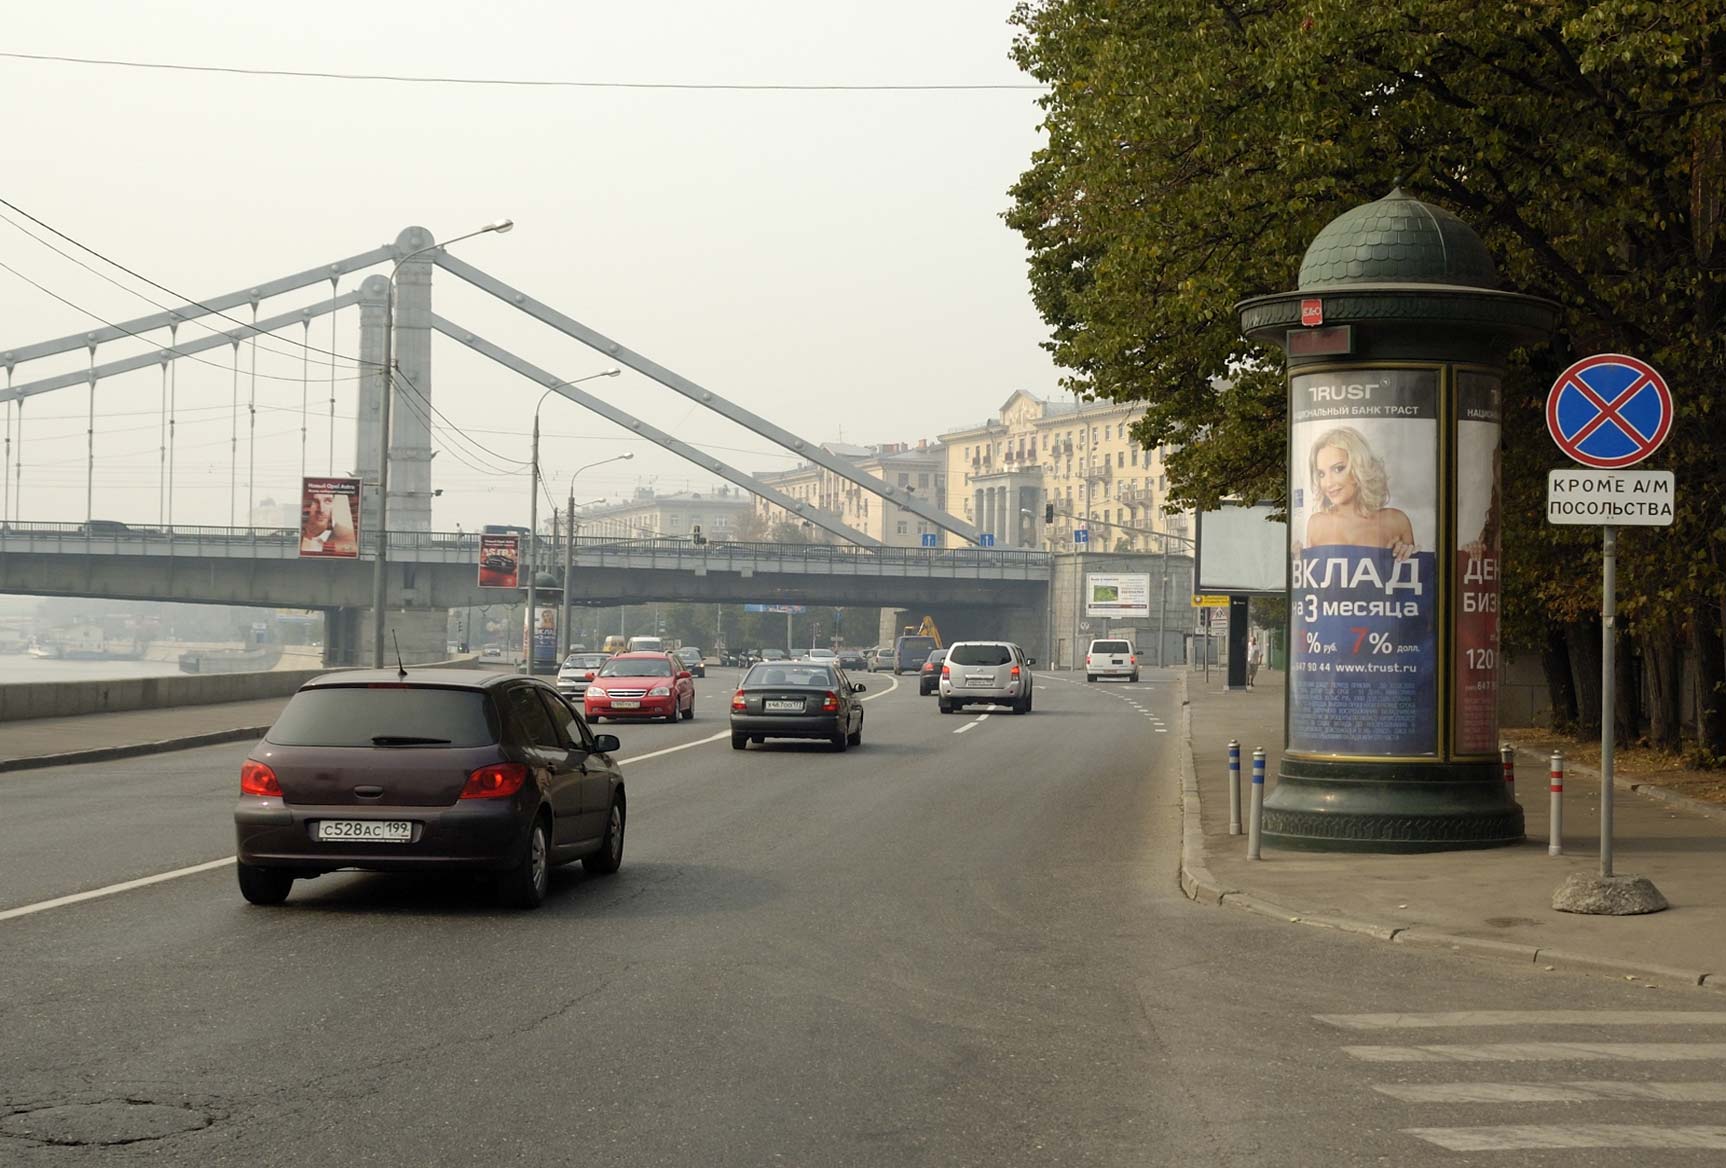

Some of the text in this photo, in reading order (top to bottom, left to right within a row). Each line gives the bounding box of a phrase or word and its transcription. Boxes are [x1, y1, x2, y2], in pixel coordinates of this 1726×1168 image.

[1308, 384, 1379, 401] TRUST
[1352, 406, 1381, 415] БАНК
[1384, 406, 1419, 415] ТРАСТ
[1553, 479, 1669, 493] КРОМЕ А/М
[1550, 501, 1672, 516] ПОСОЛЬСТВА
[1292, 557, 1423, 595] ВКЛАД
[1305, 594, 1318, 623] 3
[1323, 601, 1419, 618] месяца
[1466, 648, 1494, 669] 120
[1319, 662, 1331, 672] 44
[1335, 663, 1416, 672] www.trust.ru
[324, 823, 408, 836] С528АС 199
